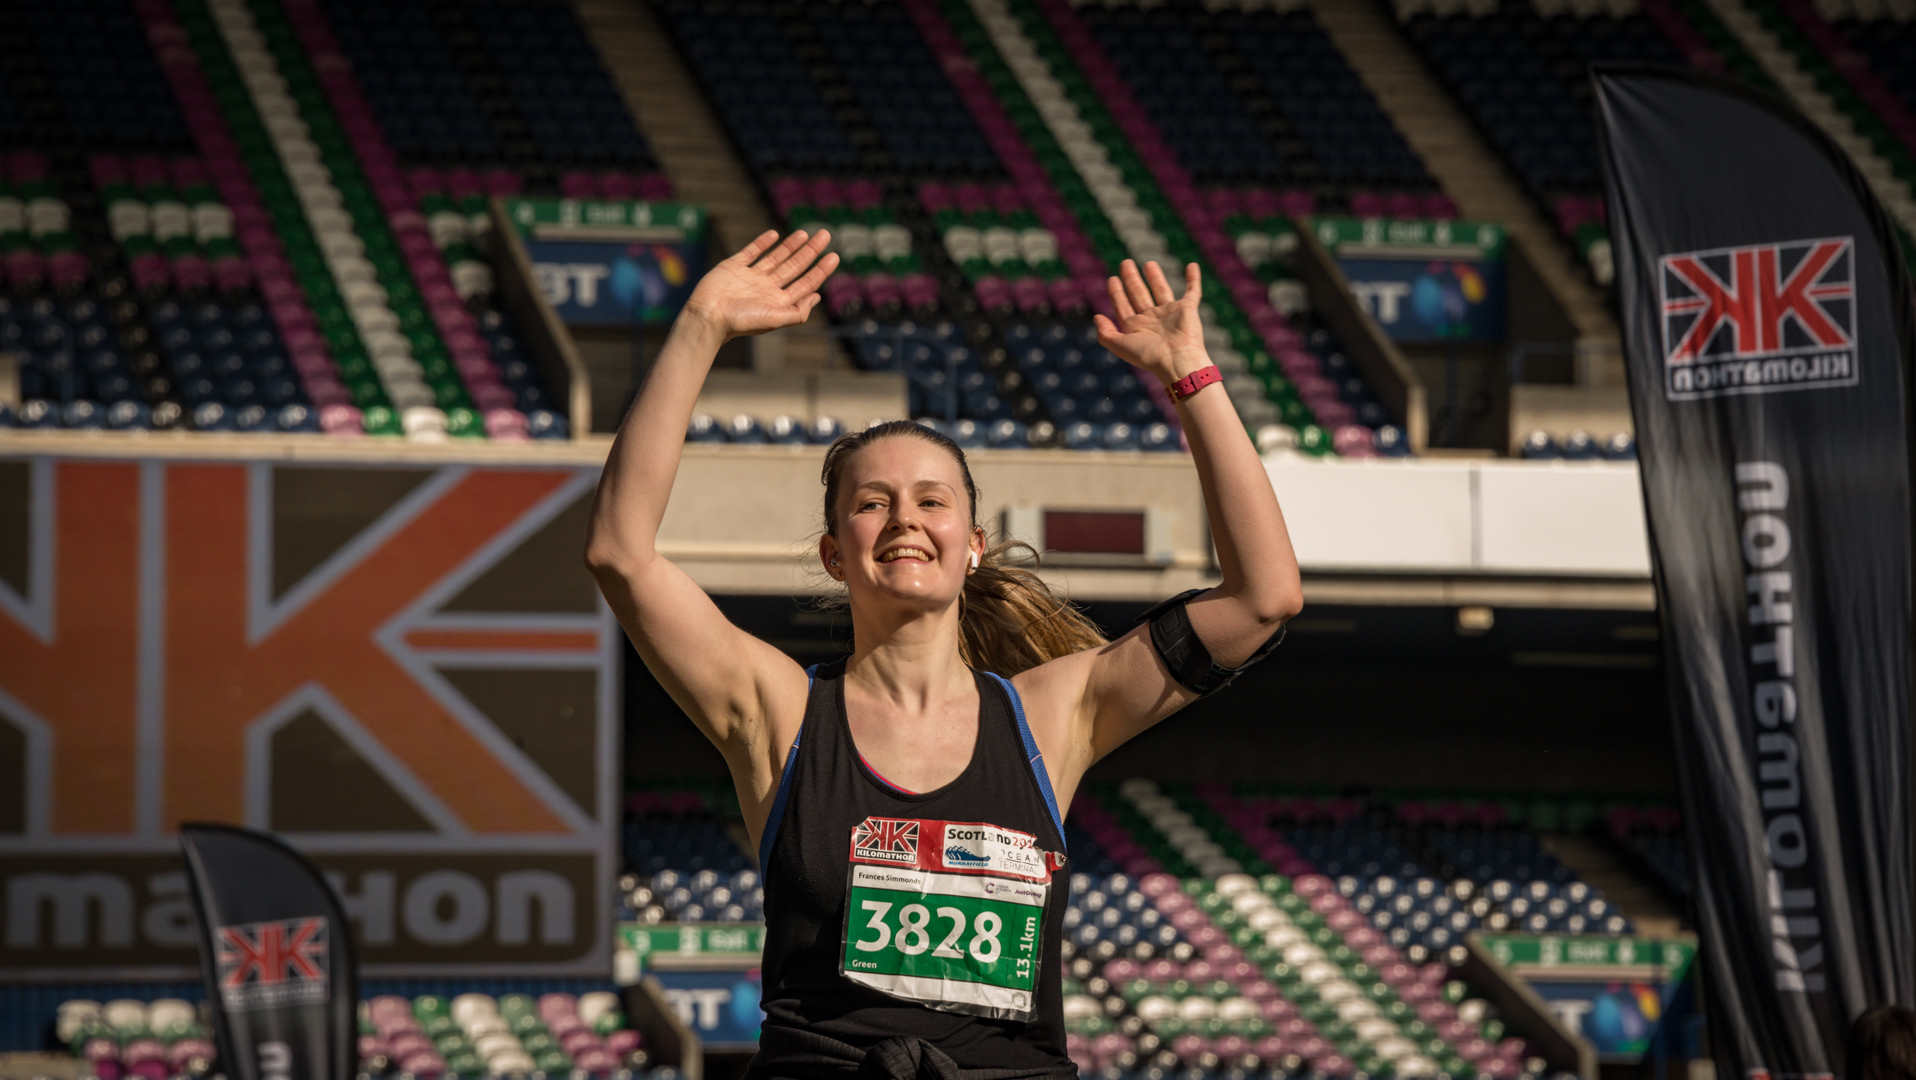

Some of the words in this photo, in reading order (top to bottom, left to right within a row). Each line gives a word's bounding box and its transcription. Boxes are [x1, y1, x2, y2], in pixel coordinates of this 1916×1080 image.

[858, 872, 885, 881] Frances
[886, 874, 921, 884] Simmonds
[1014, 889, 1042, 898] JustGiving
[855, 900, 1003, 963] 3828
[1016, 916, 1037, 979] 13.1km
[852, 959, 878, 969] Green
